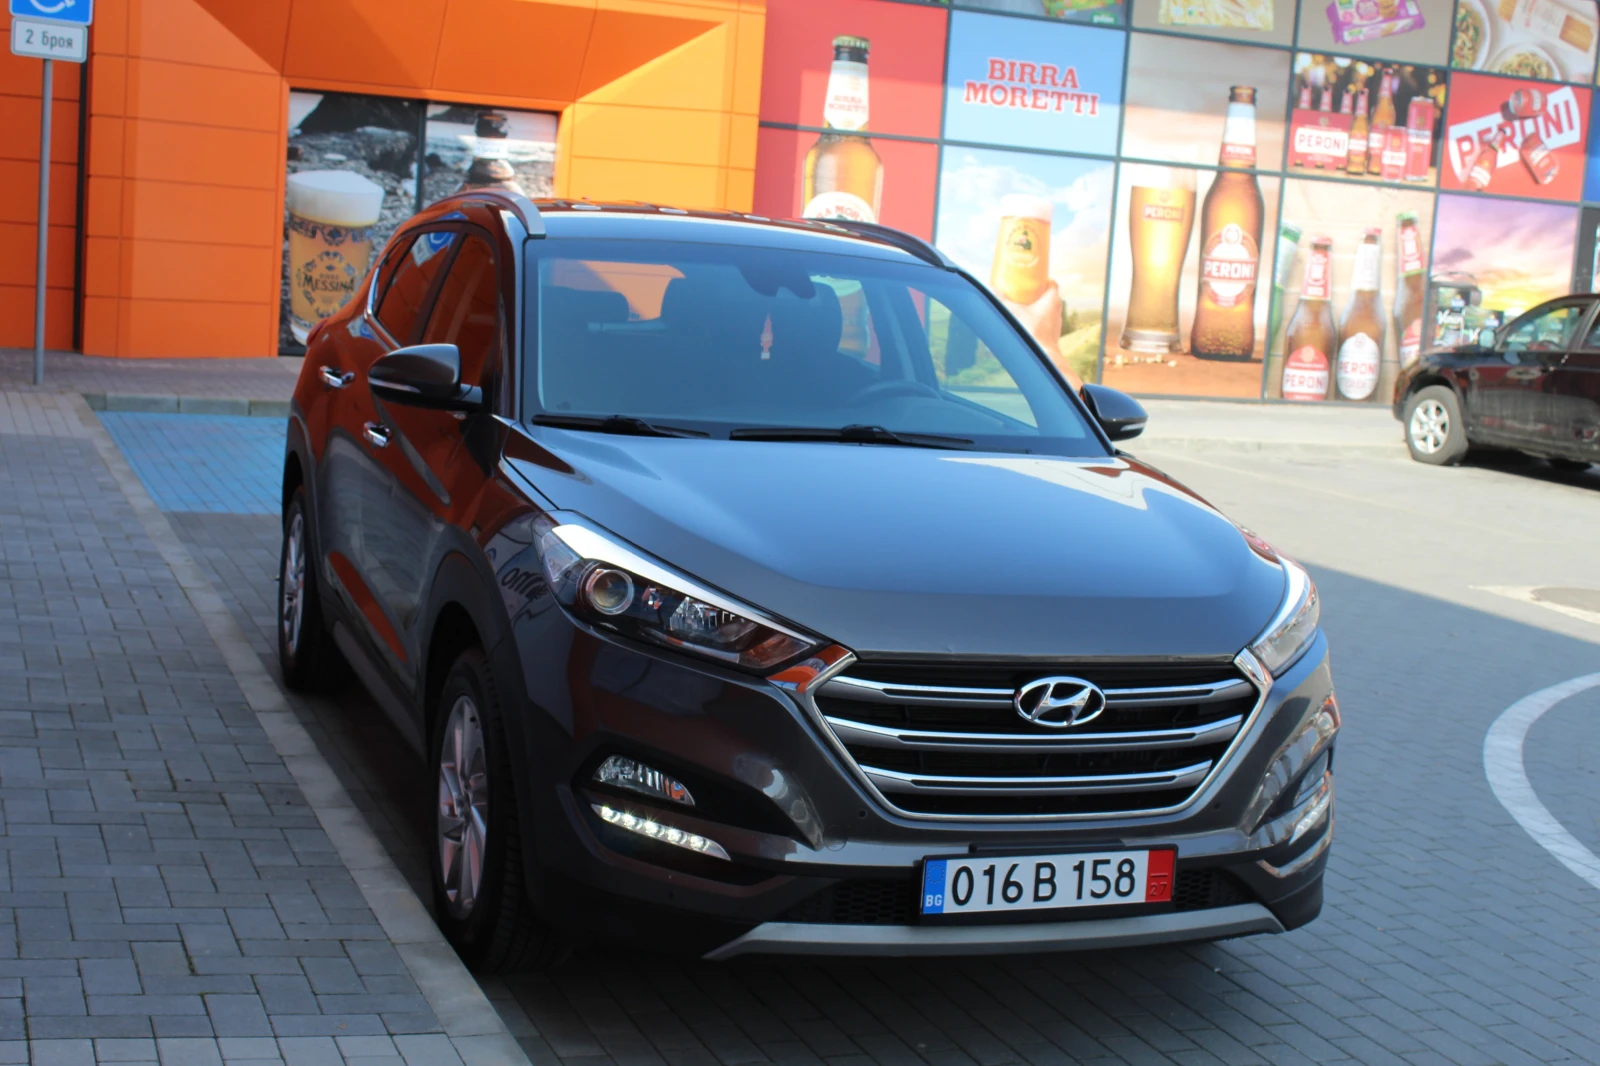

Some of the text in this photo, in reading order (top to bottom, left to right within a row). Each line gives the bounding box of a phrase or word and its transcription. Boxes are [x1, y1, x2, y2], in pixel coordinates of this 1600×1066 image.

[26, 28, 34, 44] 2
[988, 59, 1079, 88] BIRRA
[964, 81, 1099, 115] MORETTI
[1299, 134, 1345, 150] PERONI
[1204, 261, 1254, 278] PERONI
[303, 272, 354, 292] MESSINA
[952, 858, 1135, 906] 016 B 158
[1150, 882, 1167, 896] 27
[926, 894, 943, 907] BG
